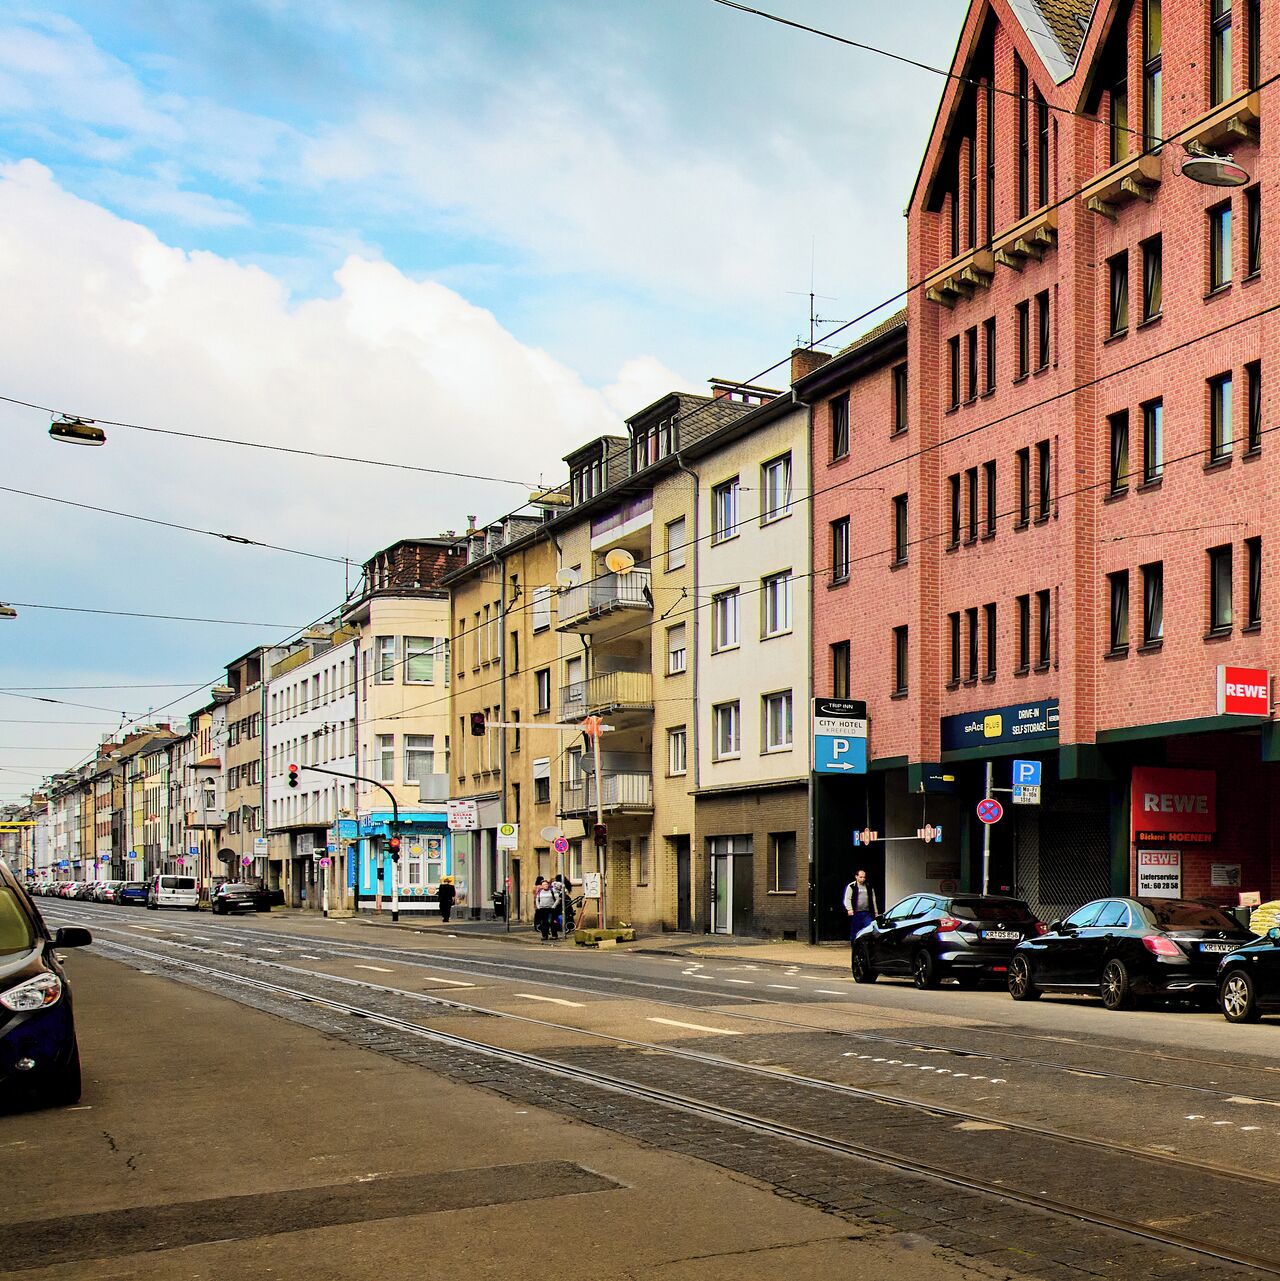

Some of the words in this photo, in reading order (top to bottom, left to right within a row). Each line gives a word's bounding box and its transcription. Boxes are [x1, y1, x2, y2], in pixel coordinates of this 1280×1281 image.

[1226, 682, 1268, 700] REWE
[1018, 708, 1040, 720] DRIVE-IN
[1012, 725, 1024, 735] SELF
[1024, 722, 1046, 734] STORAGE
[833, 738, 850, 759] P
[1020, 764, 1034, 782] P
[1144, 793, 1208, 814] REWE
[1168, 833, 1212, 842] HOENEN
[1141, 853, 1178, 864] REWE
